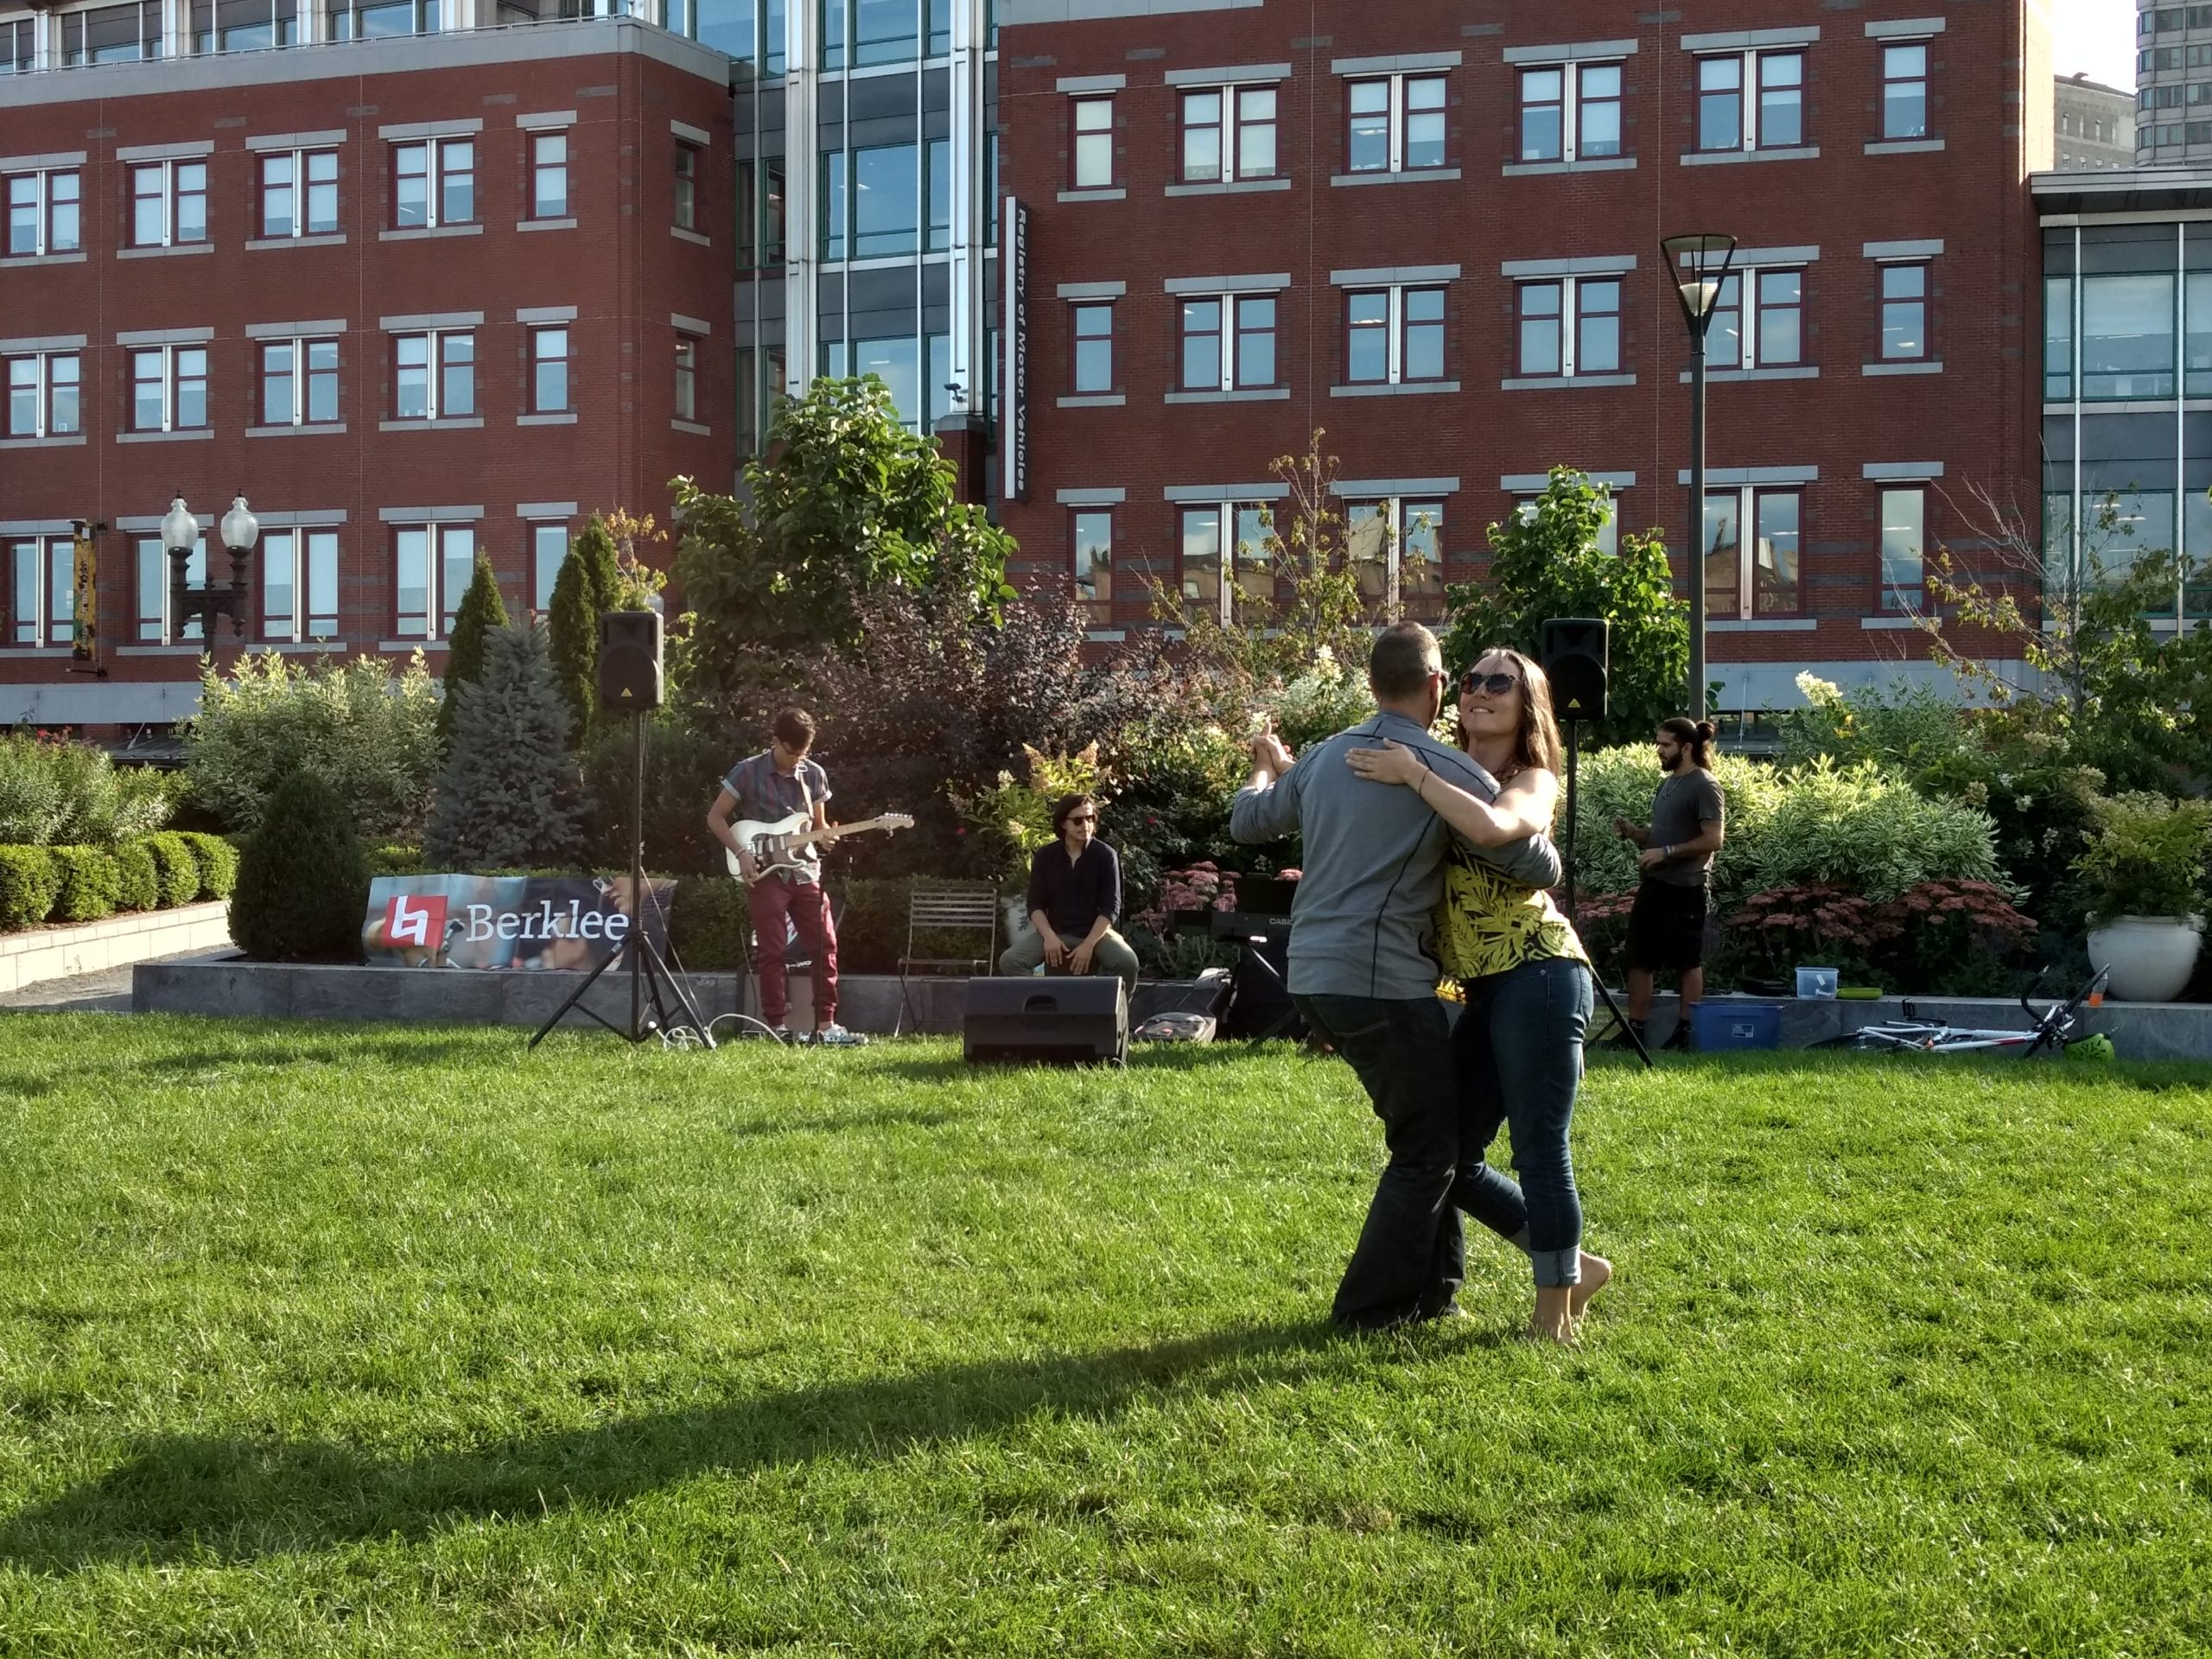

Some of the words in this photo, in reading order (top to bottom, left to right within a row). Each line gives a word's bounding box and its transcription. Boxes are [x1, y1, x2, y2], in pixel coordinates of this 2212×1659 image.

[1018, 207, 1027, 298] Registry
[1018, 303, 1027, 327] of
[1018, 331, 1027, 397] Motor
[1017, 404, 1027, 491] Vehicles
[466, 899, 629, 942] Berklee
